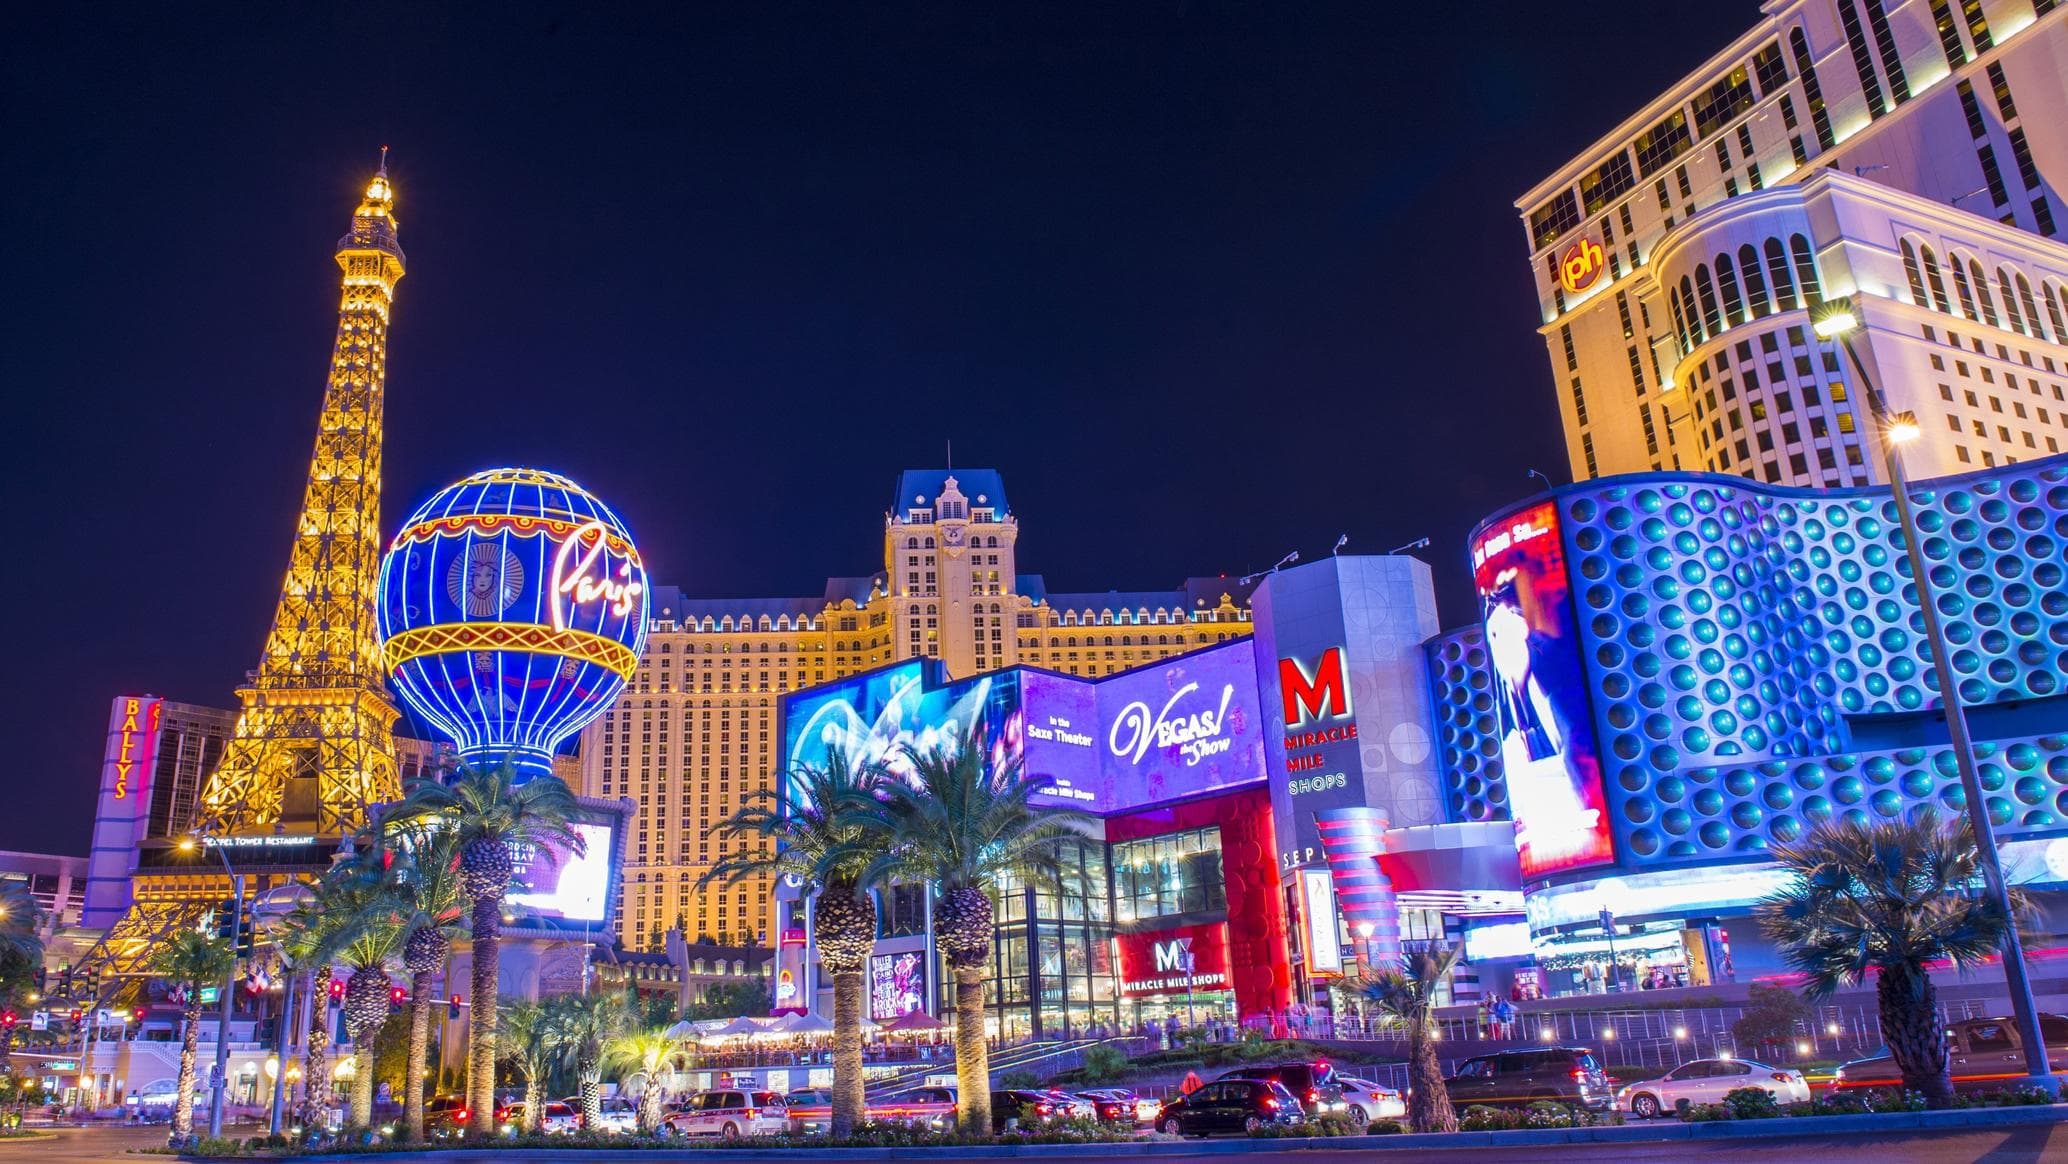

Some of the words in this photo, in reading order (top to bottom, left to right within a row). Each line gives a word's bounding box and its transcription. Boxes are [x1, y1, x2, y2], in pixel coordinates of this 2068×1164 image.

[551, 521, 642, 633] Paris
[1279, 646, 1348, 727] M
[1058, 717, 1070, 728] the
[1027, 724, 1053, 740] Saxe
[1055, 728, 1093, 747] Theater
[1284, 723, 1358, 750] MIRACLE
[1186, 738, 1231, 766] Show
[1286, 752, 1324, 772] MILE
[1288, 772, 1346, 795] SHOPS
[265, 836, 315, 845] RESTAURANT
[1123, 980, 1163, 992] MIRACLE
[1167, 977, 1188, 986] MILE
[1191, 974, 1225, 985] SHOPS
